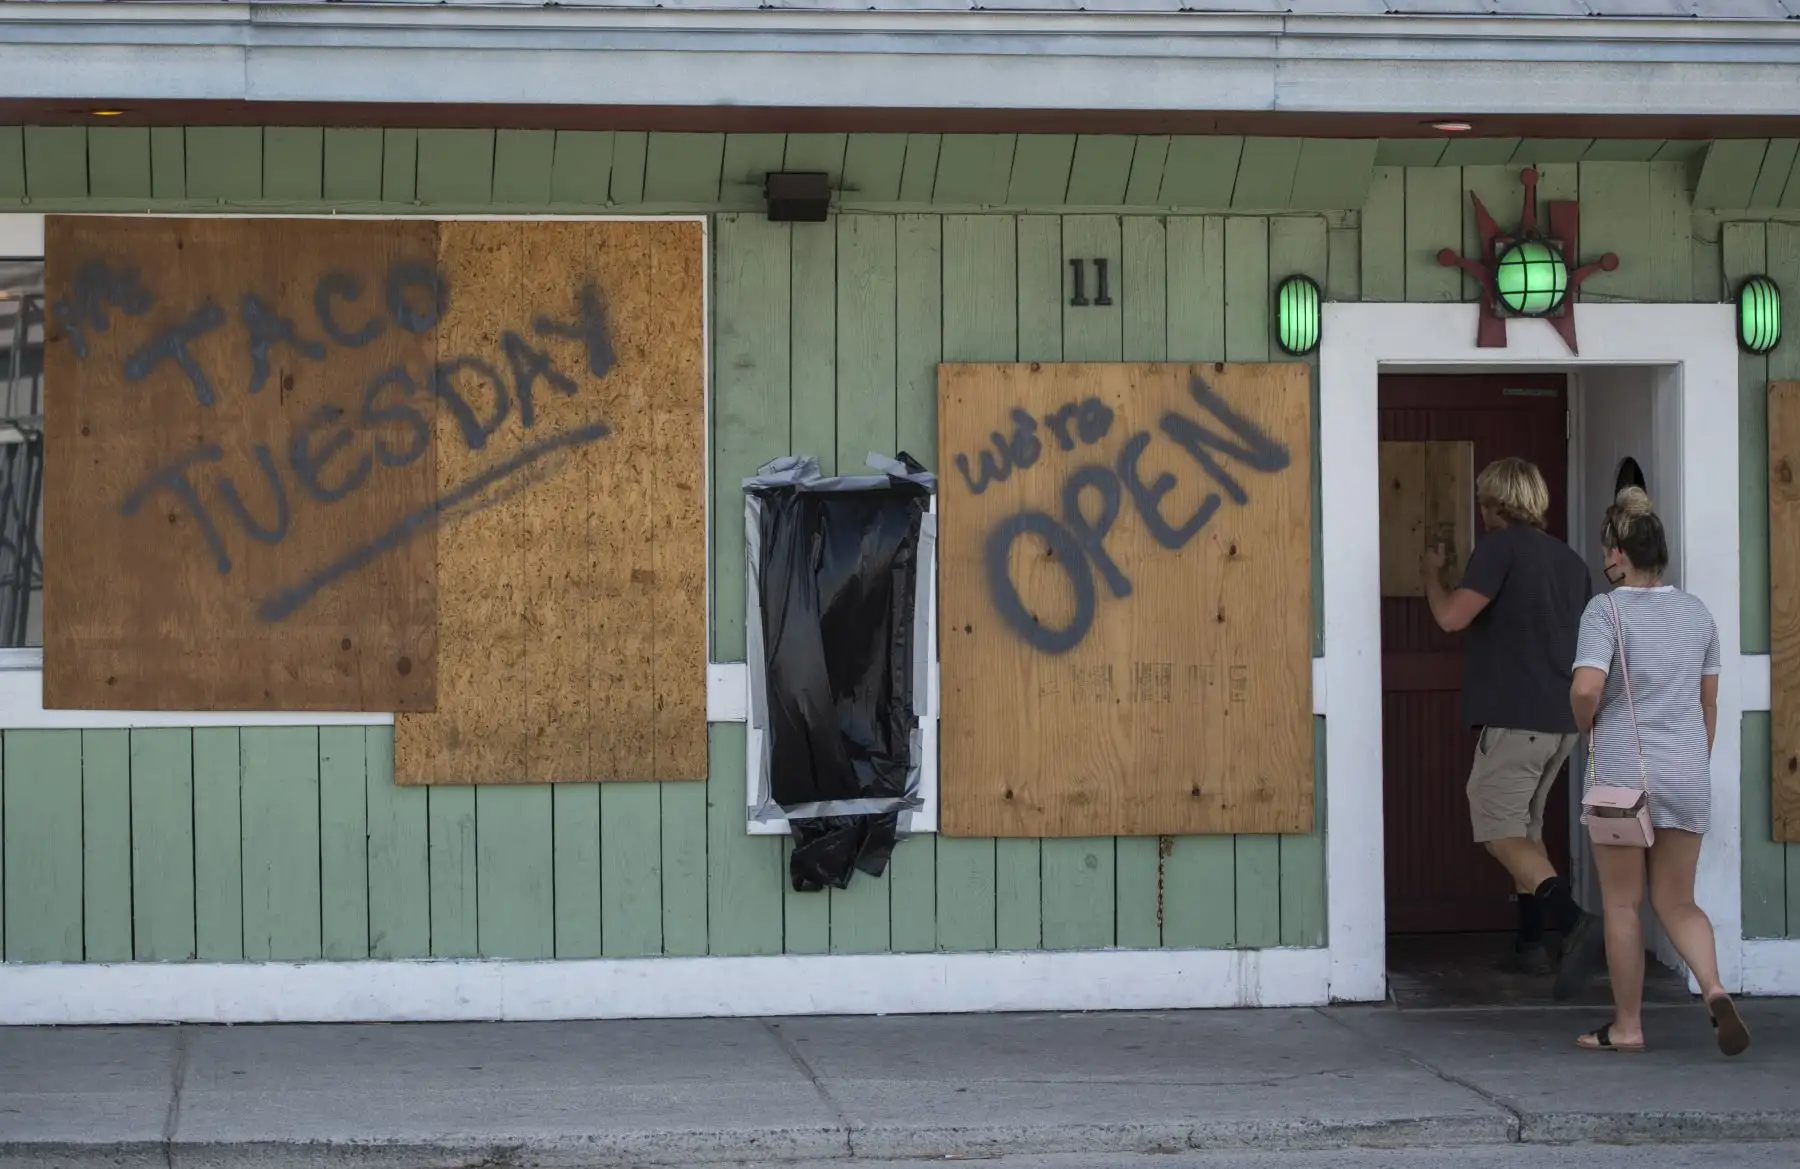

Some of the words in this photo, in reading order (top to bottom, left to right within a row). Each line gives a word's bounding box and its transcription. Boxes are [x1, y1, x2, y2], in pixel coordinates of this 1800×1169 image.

[124, 262, 449, 407] TACO
[1069, 258, 1112, 306] 11
[120, 277, 616, 575] TUESDAY
[985, 370, 1290, 654] OPEN
